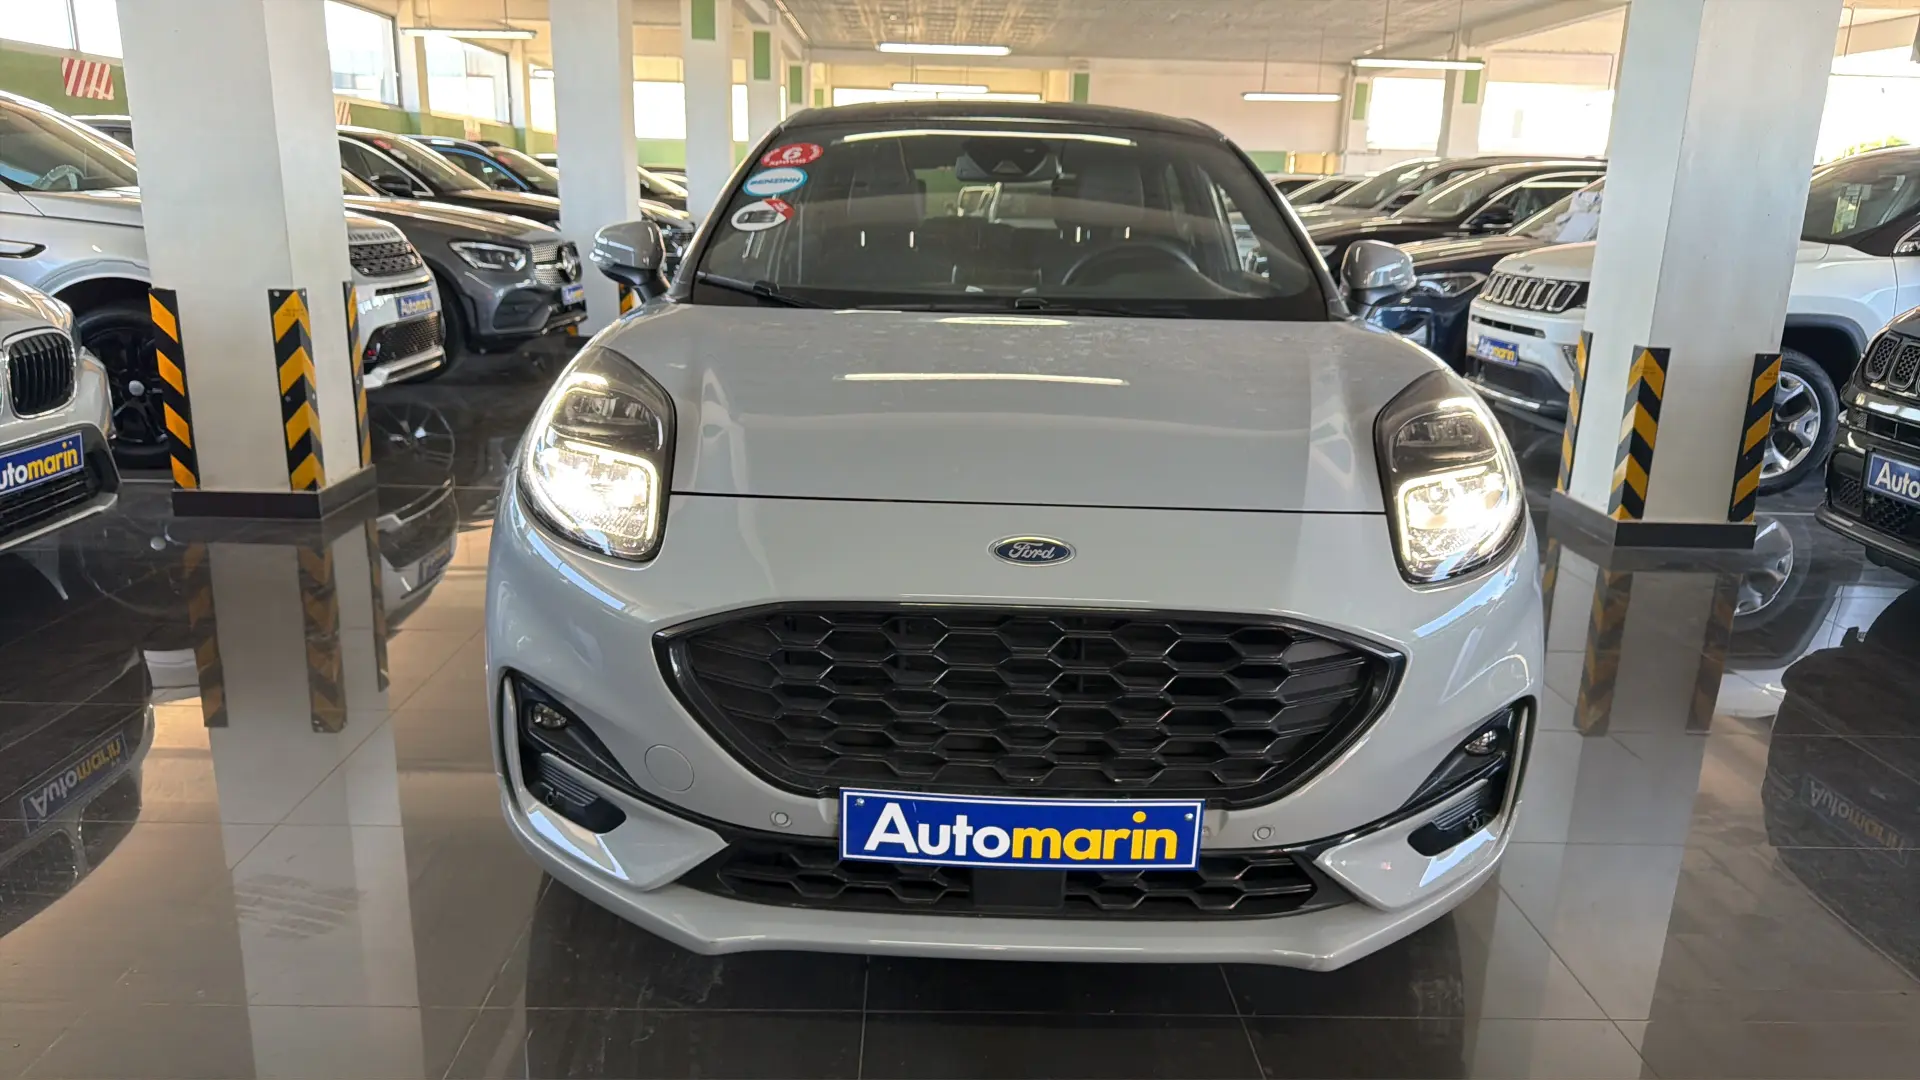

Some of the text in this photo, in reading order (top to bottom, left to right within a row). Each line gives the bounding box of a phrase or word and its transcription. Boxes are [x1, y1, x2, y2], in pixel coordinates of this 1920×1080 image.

[782, 147, 803, 161] 6
[1874, 462, 1920, 498] Auto
[1008, 542, 1055, 559] Ford
[863, 802, 1178, 860] Automarin
